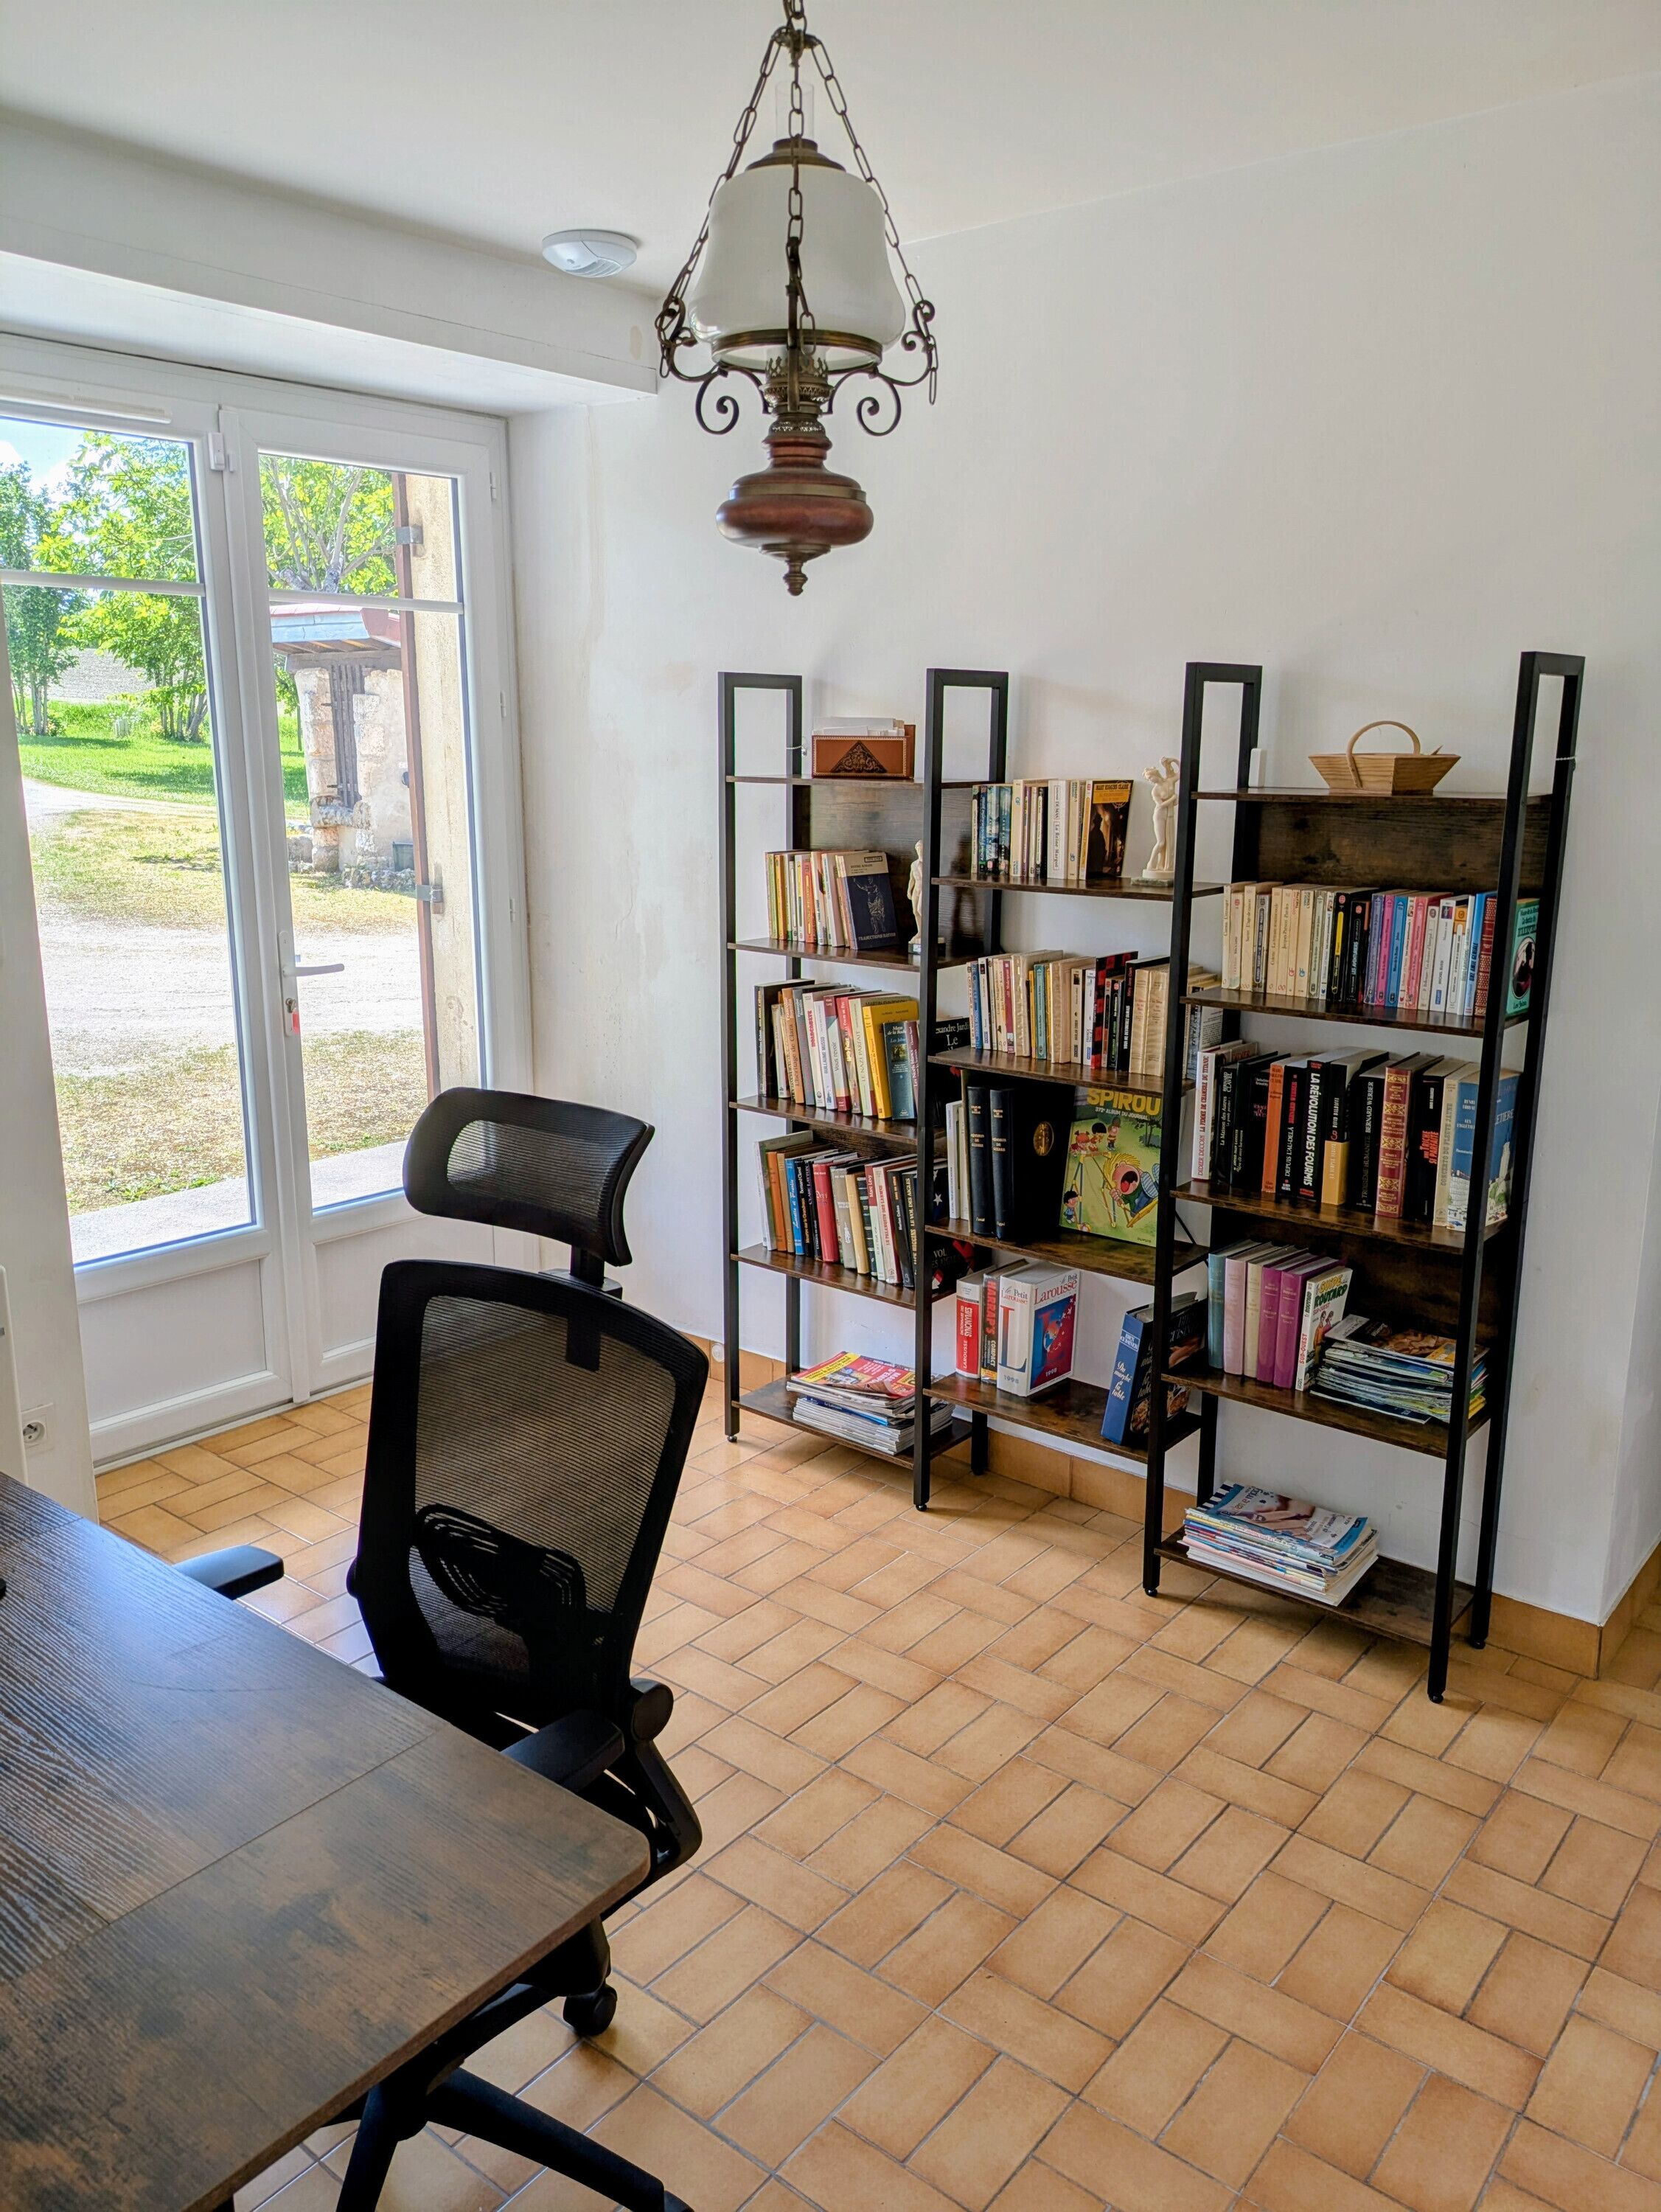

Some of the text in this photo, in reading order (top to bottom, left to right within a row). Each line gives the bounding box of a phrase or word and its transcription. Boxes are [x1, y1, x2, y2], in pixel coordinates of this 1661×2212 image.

[935, 1023, 956, 1034] xandre
[946, 1034, 958, 1046] Le
[855, 1031, 863, 1056] PARFAIT
[790, 1053, 800, 1087] L'héritage
[1087, 1088, 1161, 1116] SPIROU
[1127, 1112, 1148, 1120] JOURNAL
[1365, 1106, 1373, 1133] BERNARD
[1303, 1073, 1322, 1186] LA RÉVOLUTION DES FOURMIS
[1429, 1131, 1439, 1158] PARFAITE
[933, 1248, 947, 1258] VOL
[1014, 1289, 1028, 1300] Petit
[1034, 1280, 1077, 1305] Larousse
[1319, 1273, 1343, 1293] GUIDE
[985, 1279, 997, 1335] HARRAP'S
[1001, 1290, 1028, 1304] Larousse
[1314, 1284, 1348, 1307] ROUTARD
[964, 1307, 972, 1338] SYNONYMES
[1298, 1334, 1308, 1364] SUD-OUEST
[1114, 1371, 1132, 1382] marché
[1117, 1361, 1126, 1371] Du
[1112, 1390, 1126, 1401] table
